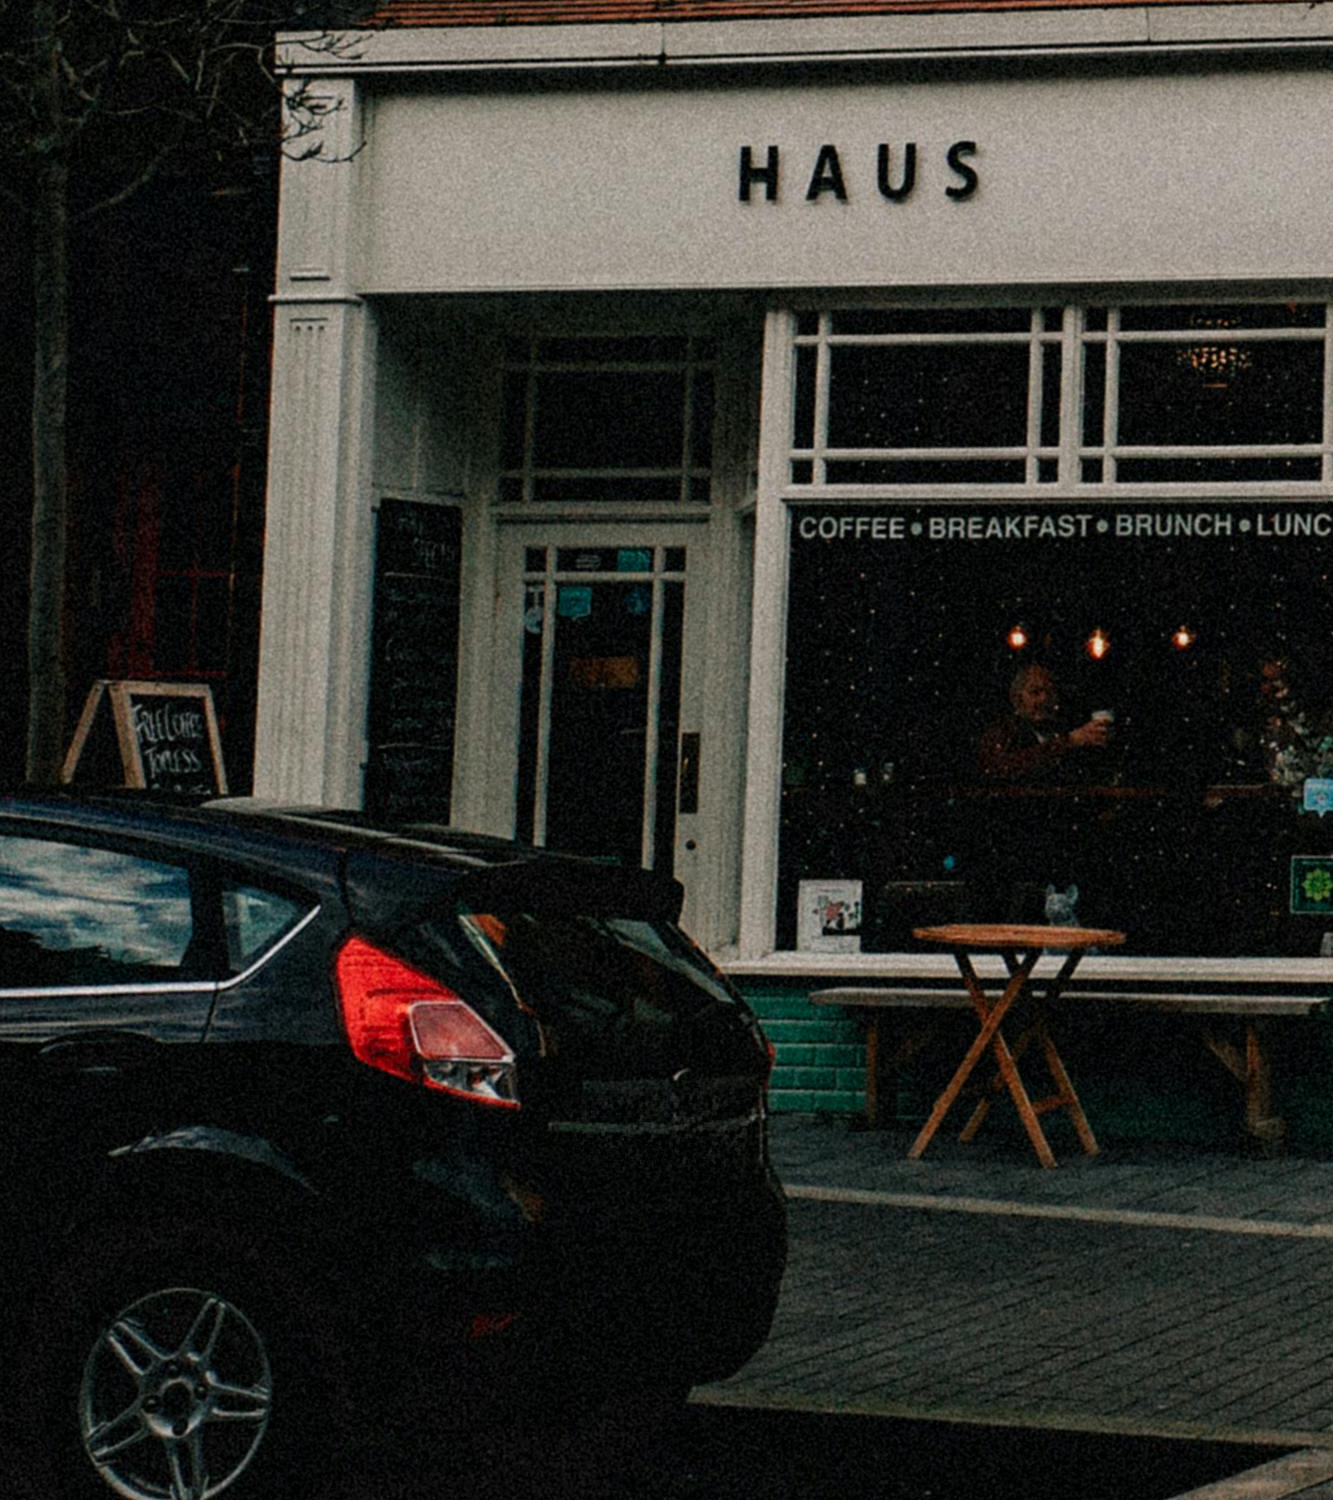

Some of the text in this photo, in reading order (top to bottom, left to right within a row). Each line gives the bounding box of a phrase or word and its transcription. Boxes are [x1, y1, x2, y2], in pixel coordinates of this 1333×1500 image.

[739, 140, 979, 203] HAUS
[799, 515, 906, 540] COFFEE
[929, 514, 1092, 539] BREAKFAST
[1116, 513, 1232, 538] BRUNCH
